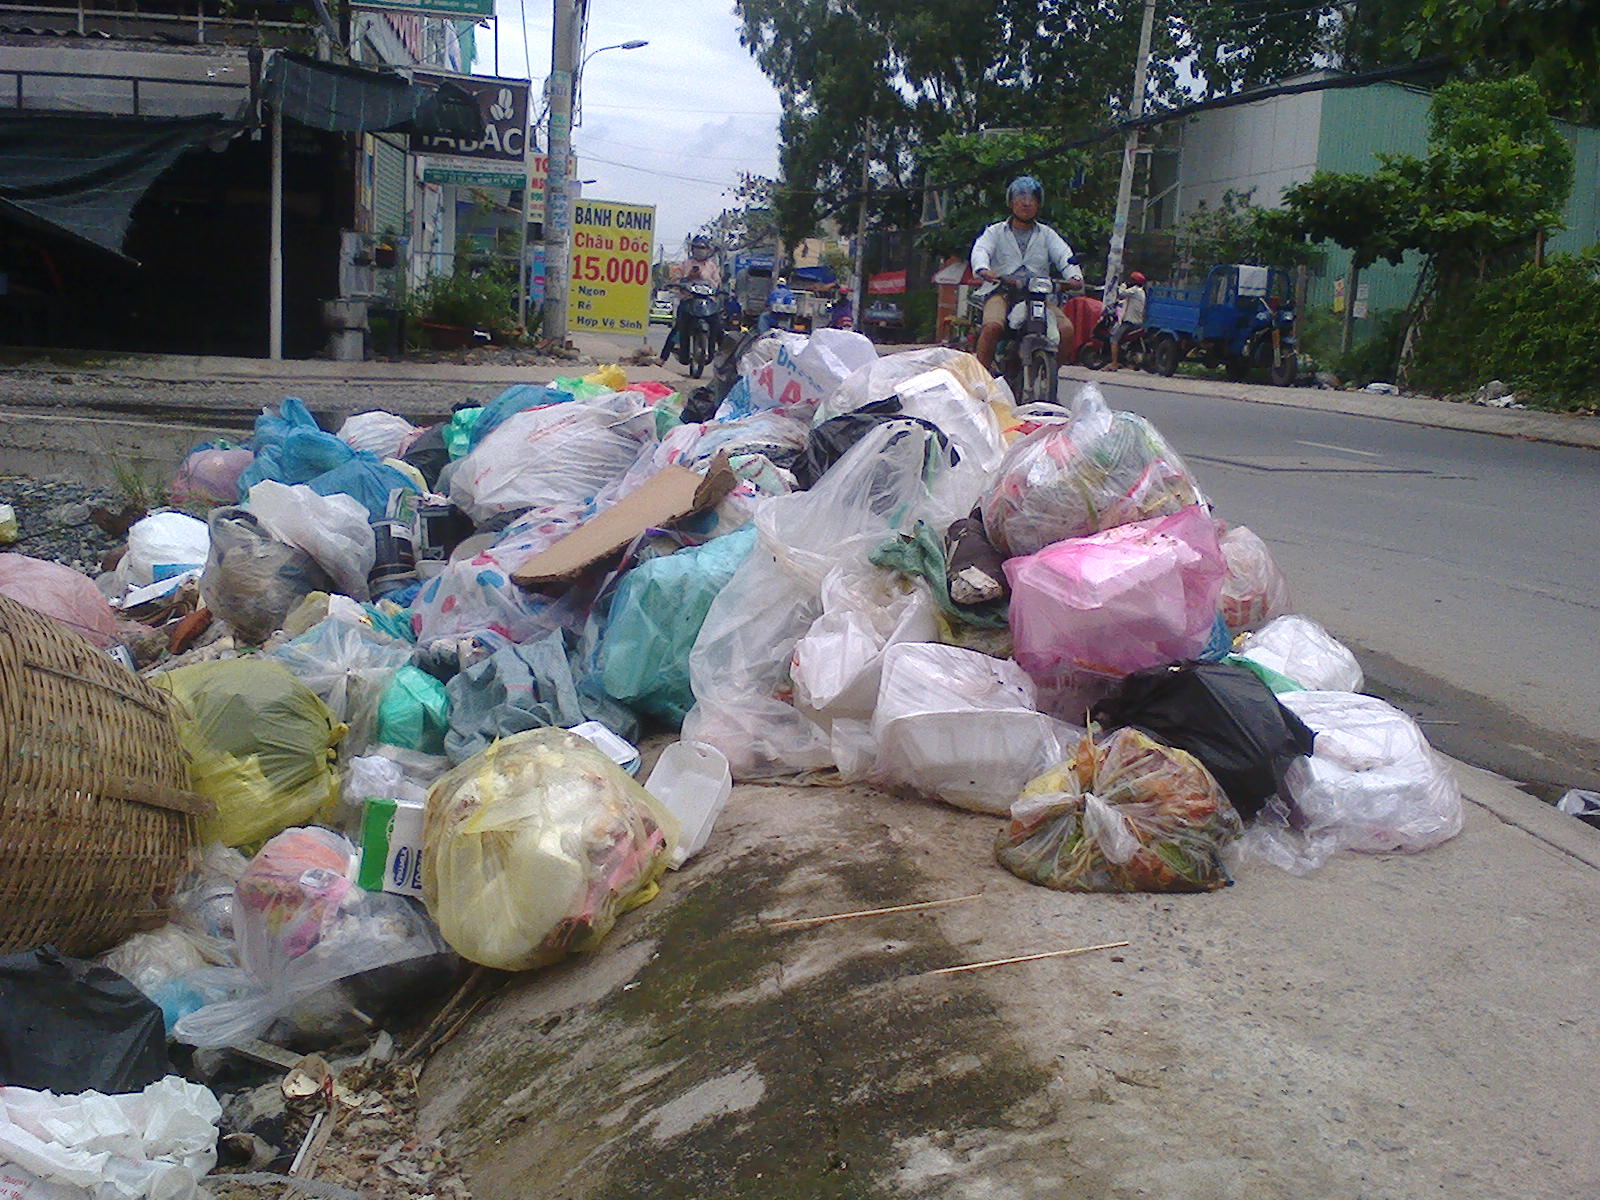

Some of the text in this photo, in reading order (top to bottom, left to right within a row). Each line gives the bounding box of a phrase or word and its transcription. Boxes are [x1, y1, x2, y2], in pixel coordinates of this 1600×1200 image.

[616, 210, 652, 230] CANH
[575, 232, 649, 253] Châu Đốc
[572, 254, 649, 285] 15.000
[620, 320, 643, 329] Sinh
